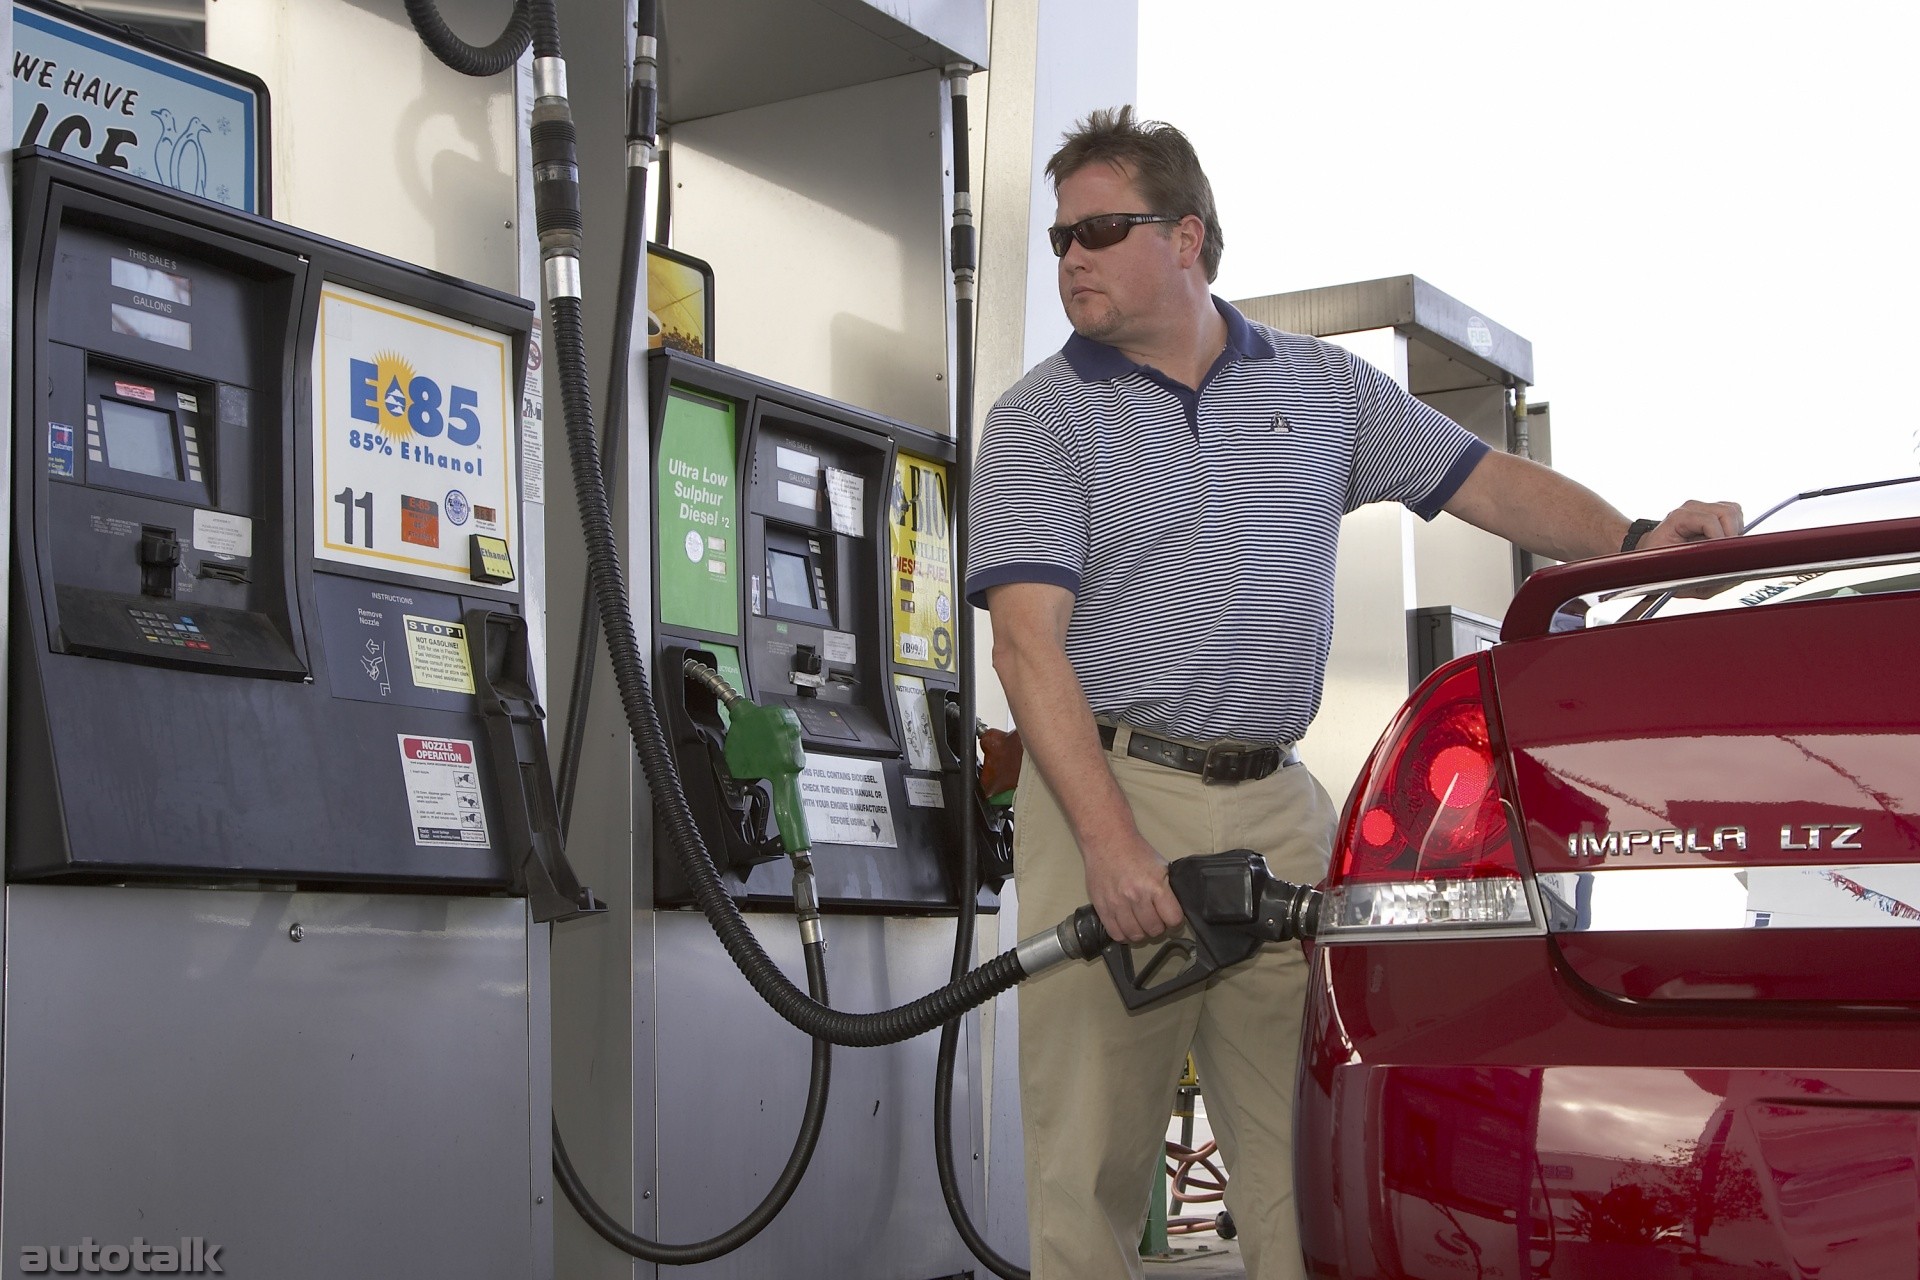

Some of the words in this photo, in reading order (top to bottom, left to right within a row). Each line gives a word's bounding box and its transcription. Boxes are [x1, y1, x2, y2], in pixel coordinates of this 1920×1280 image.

[13, 51, 57, 89] WE
[63, 69, 139, 116] HAVE
[19, 102, 138, 169] ICE
[128, 248, 147, 263] THIS
[149, 252, 170, 268] SALE
[171, 260, 177, 270] $
[133, 295, 172, 314] GALLONS
[349, 429, 392, 456] 85%
[401, 441, 483, 476] Ethanol
[668, 458, 699, 480] Ultra
[702, 467, 728, 487] Low
[789, 473, 810, 485] GALLONS
[674, 480, 724, 506] Sulphur
[909, 464, 946, 540] BIO
[334, 486, 373, 548] 11
[680, 502, 718, 526] Diesel
[480, 547, 508, 561] Ethanol
[910, 540, 948, 564] WILLIE
[372, 592, 414, 604] INSTRUCTIONS
[358, 608, 382, 618] Remove
[360, 617, 380, 626] Nozzle
[409, 621, 462, 638] STOP!
[416, 636, 427, 644] NOT
[429, 638, 458, 650] GASOLINE!
[933, 626, 952, 670] 9
[422, 740, 454, 752] NOZZLE
[416, 750, 462, 762] OPERATION
[813, 769, 826, 778] FUEL
[826, 771, 851, 780] CONTAINS
[802, 783, 820, 792] CHECK
[820, 785, 830, 793] THE
[832, 786, 854, 796] OWNER'S
[854, 788, 874, 798] MANUAL
[816, 800, 830, 808] YOUR
[831, 801, 849, 810] ENGINE
[849, 803, 888, 814] MANUFACTURER
[830, 816, 850, 825] BEFORE
[1567, 826, 1748, 858] IMPALA
[1780, 824, 1863, 852] LTZ
